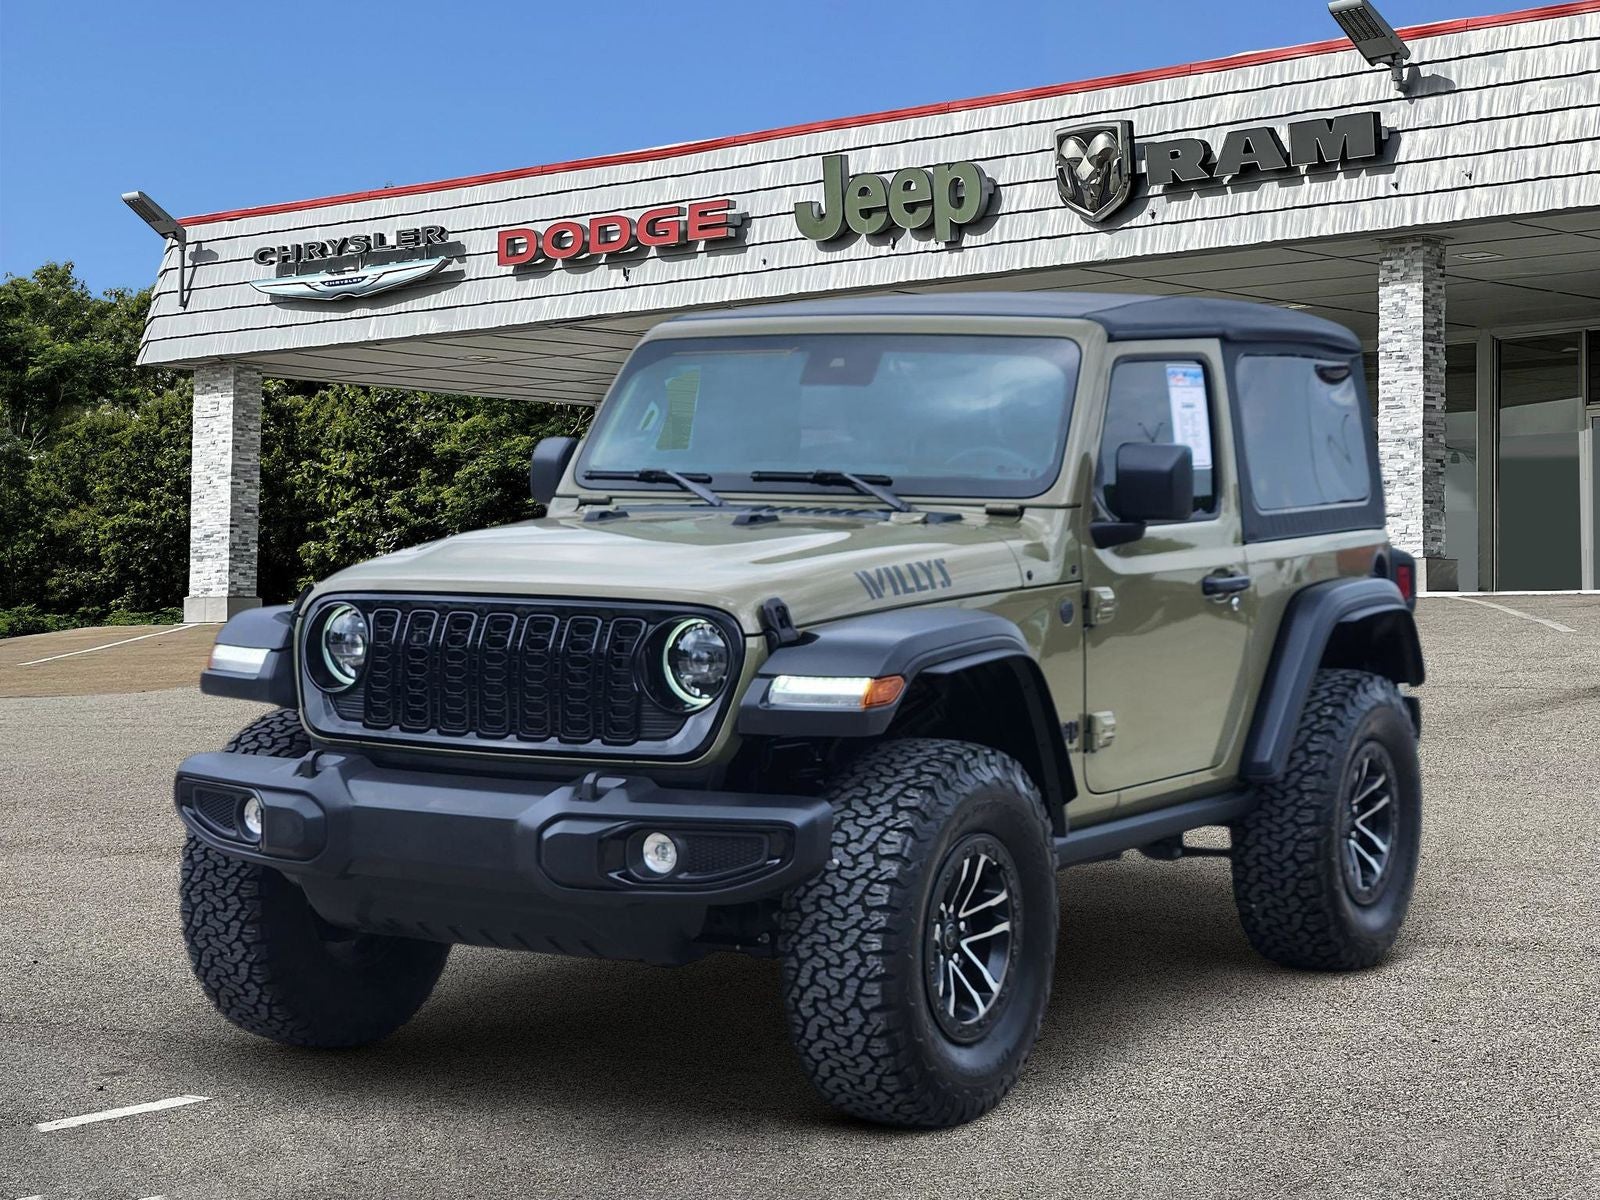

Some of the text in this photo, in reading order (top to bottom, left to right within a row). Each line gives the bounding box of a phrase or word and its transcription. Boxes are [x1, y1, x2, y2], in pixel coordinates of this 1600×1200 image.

[1145, 111, 1381, 187] RAM
[794, 154, 990, 242] Jeep
[252, 225, 449, 266] CHRYSLER
[497, 199, 736, 267] DODGE
[324, 277, 362, 287] CHRYSLER
[854, 558, 952, 600] WILLYS
